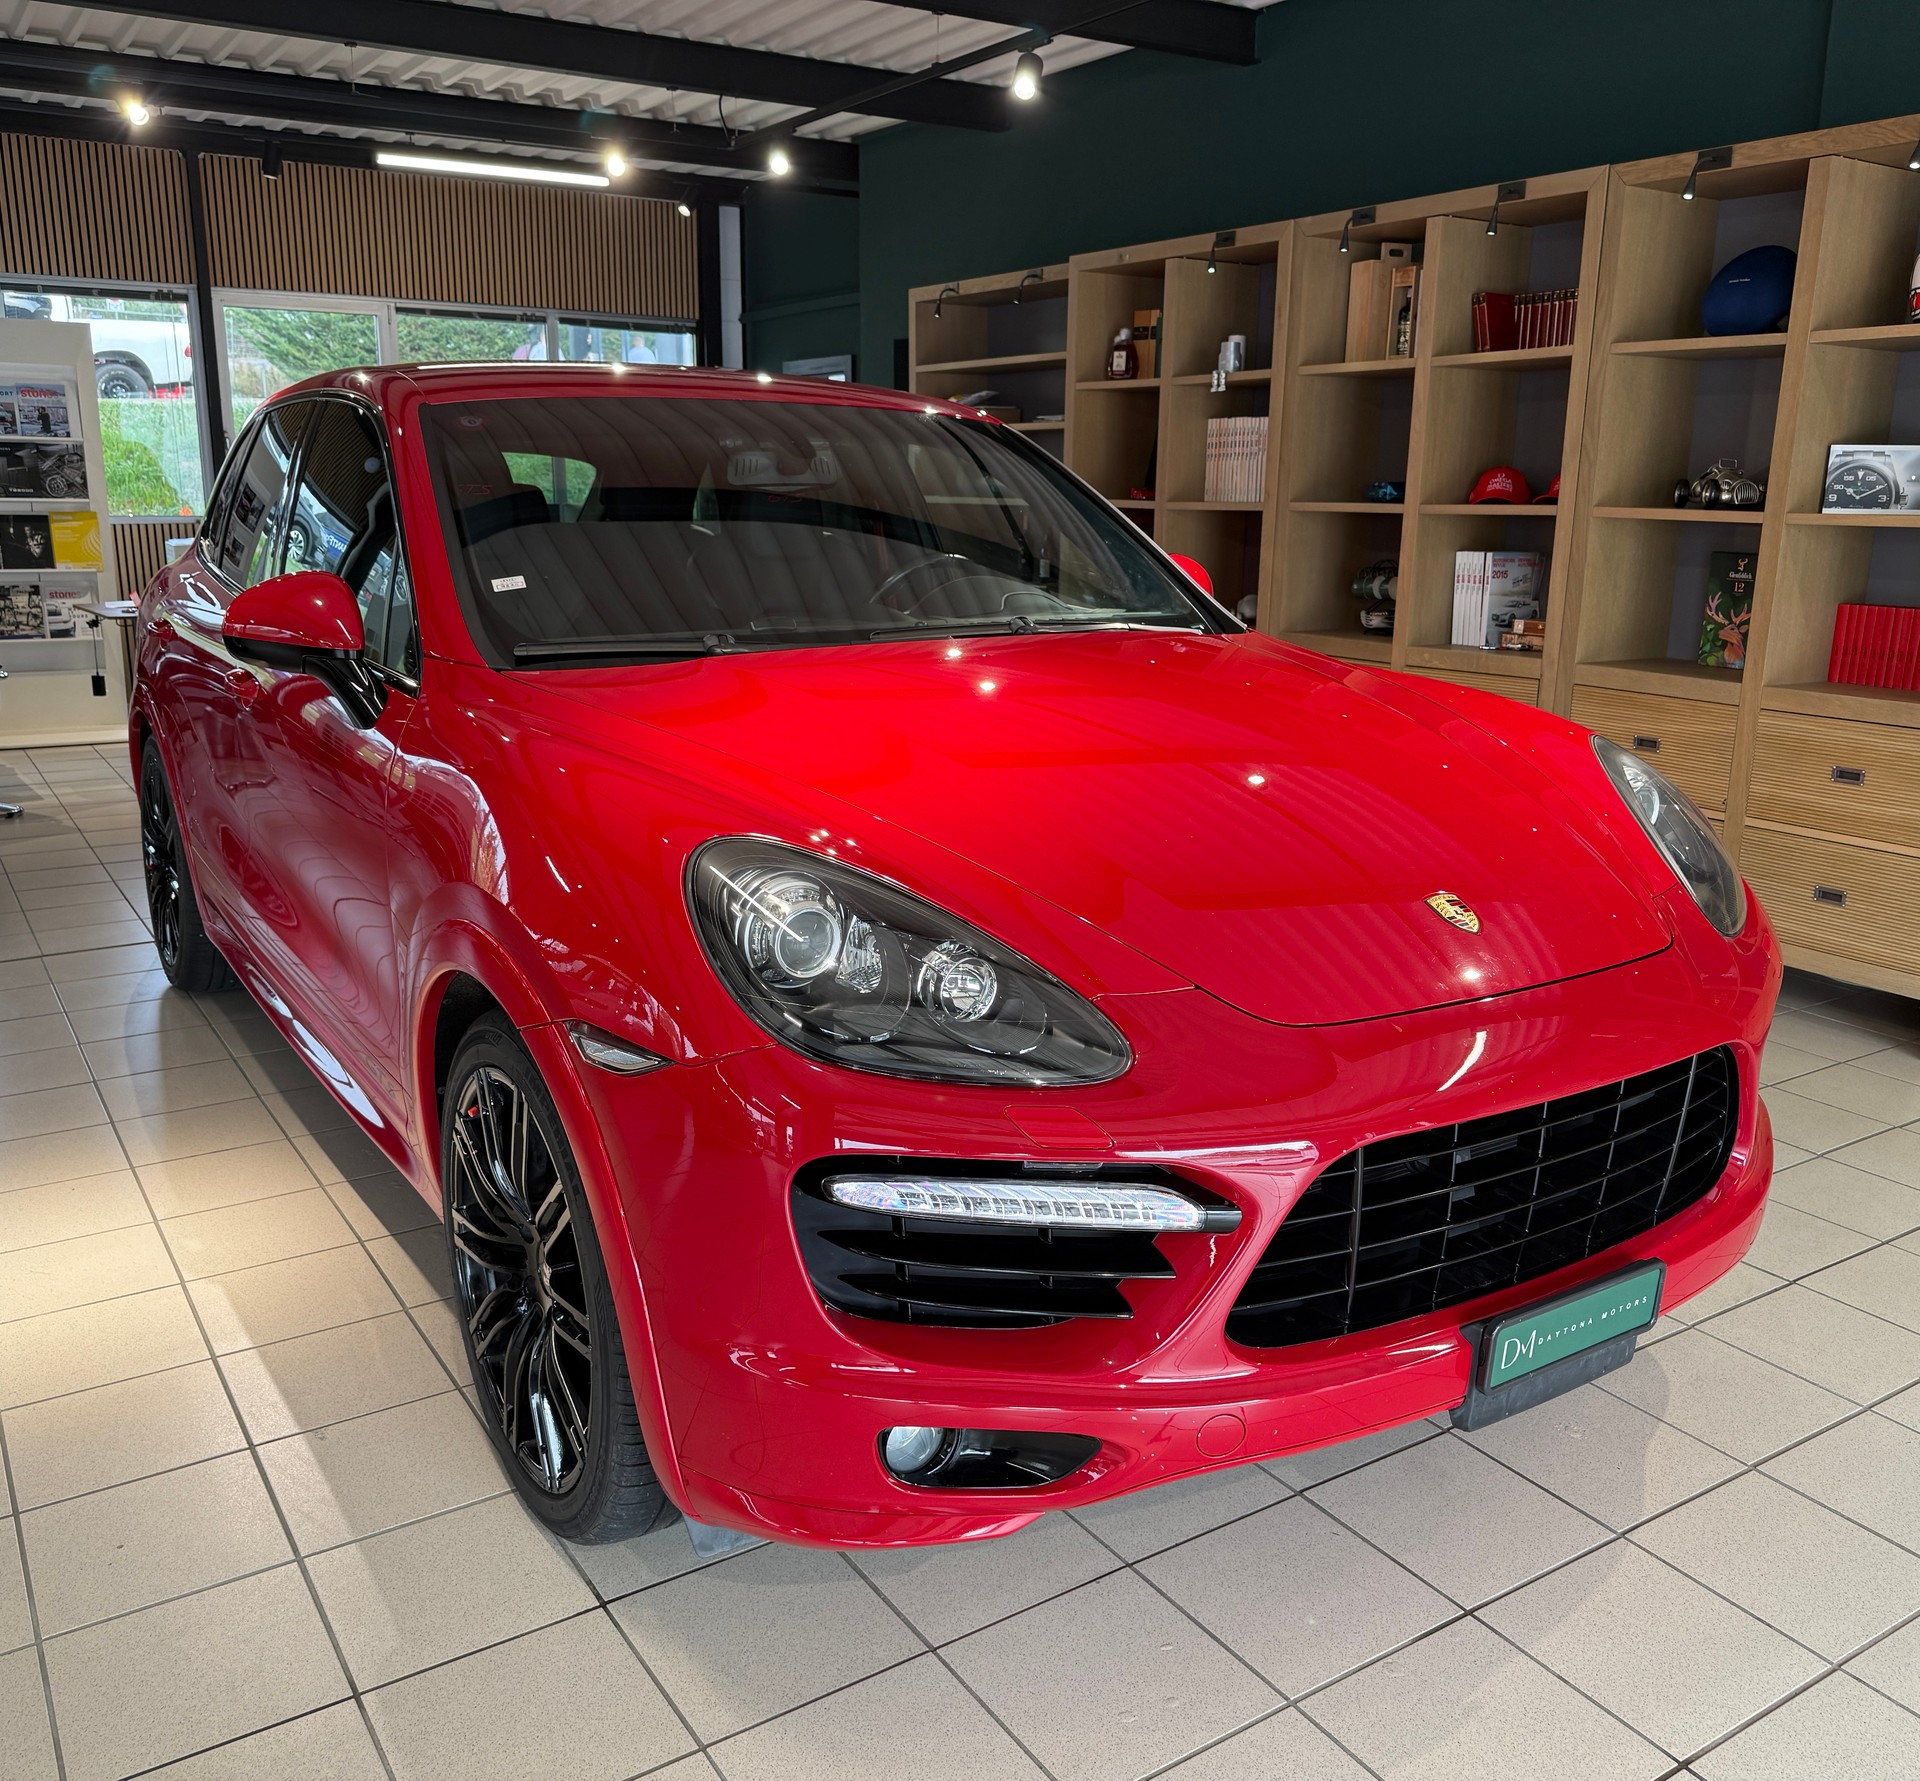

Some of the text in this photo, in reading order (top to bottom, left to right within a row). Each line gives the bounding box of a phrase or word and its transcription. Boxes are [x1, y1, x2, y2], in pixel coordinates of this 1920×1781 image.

[1492, 570, 1509, 579] 2015
[1734, 582, 1745, 592] 12
[1538, 1317, 1594, 1345] DAYTONA
[1601, 1295, 1648, 1319] MOTORS
